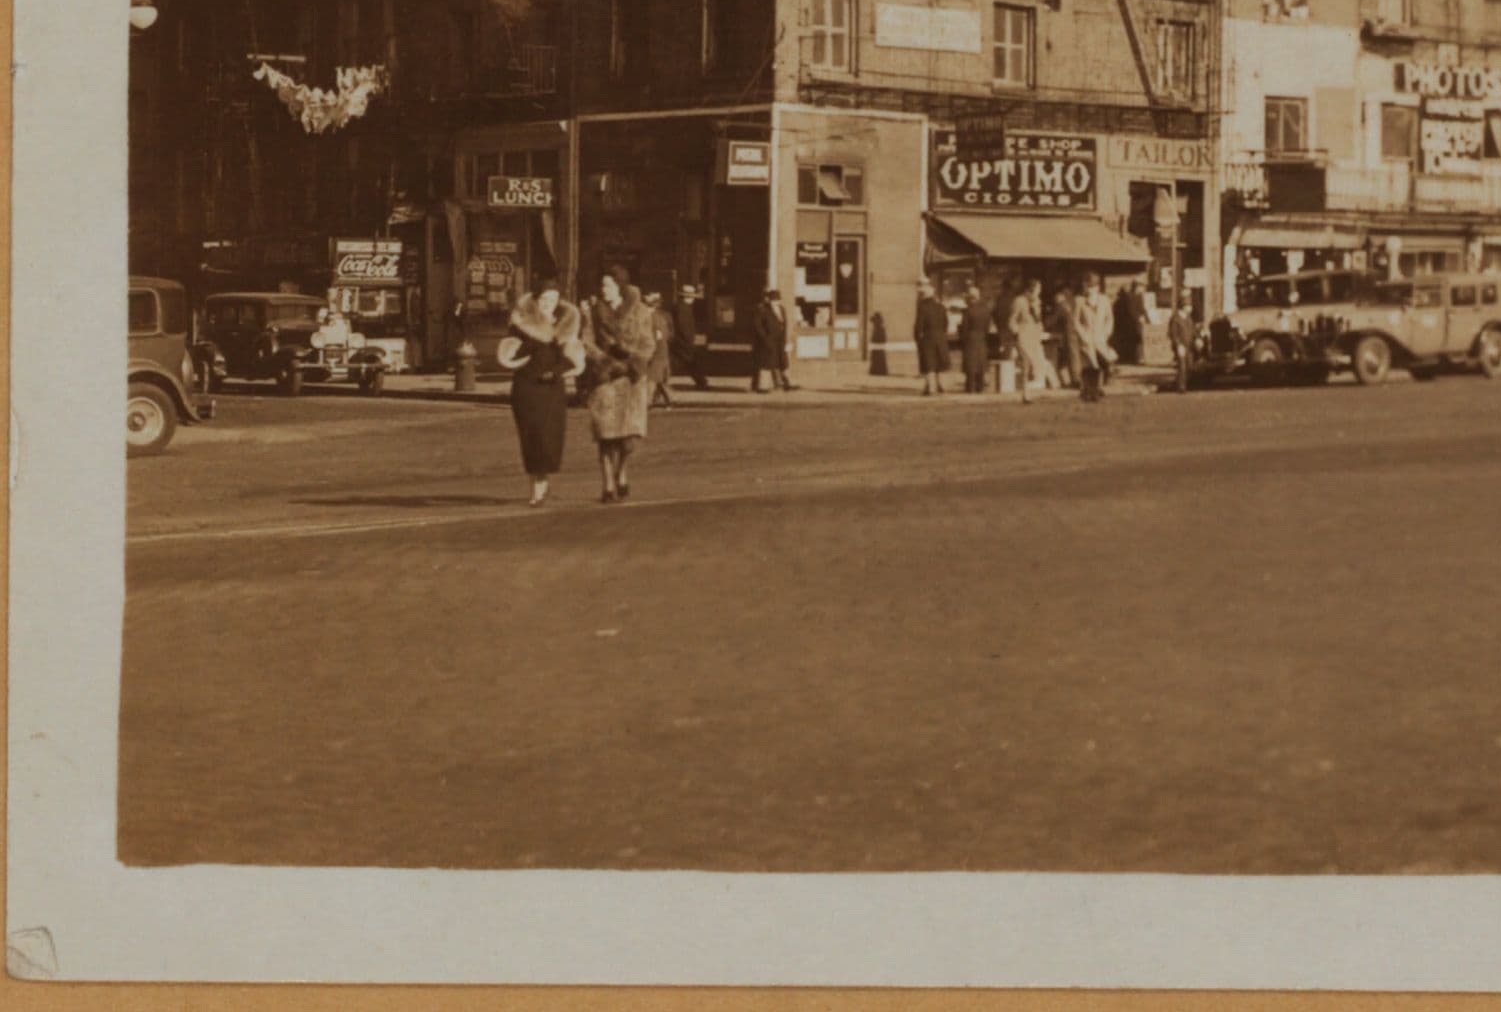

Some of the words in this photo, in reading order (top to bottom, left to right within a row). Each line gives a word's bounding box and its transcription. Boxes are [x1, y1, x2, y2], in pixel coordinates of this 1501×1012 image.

[1117, 139, 1214, 167] TAILOR
[940, 156, 1091, 194] OPTIMO
[964, 192, 1072, 207] CIGARS
